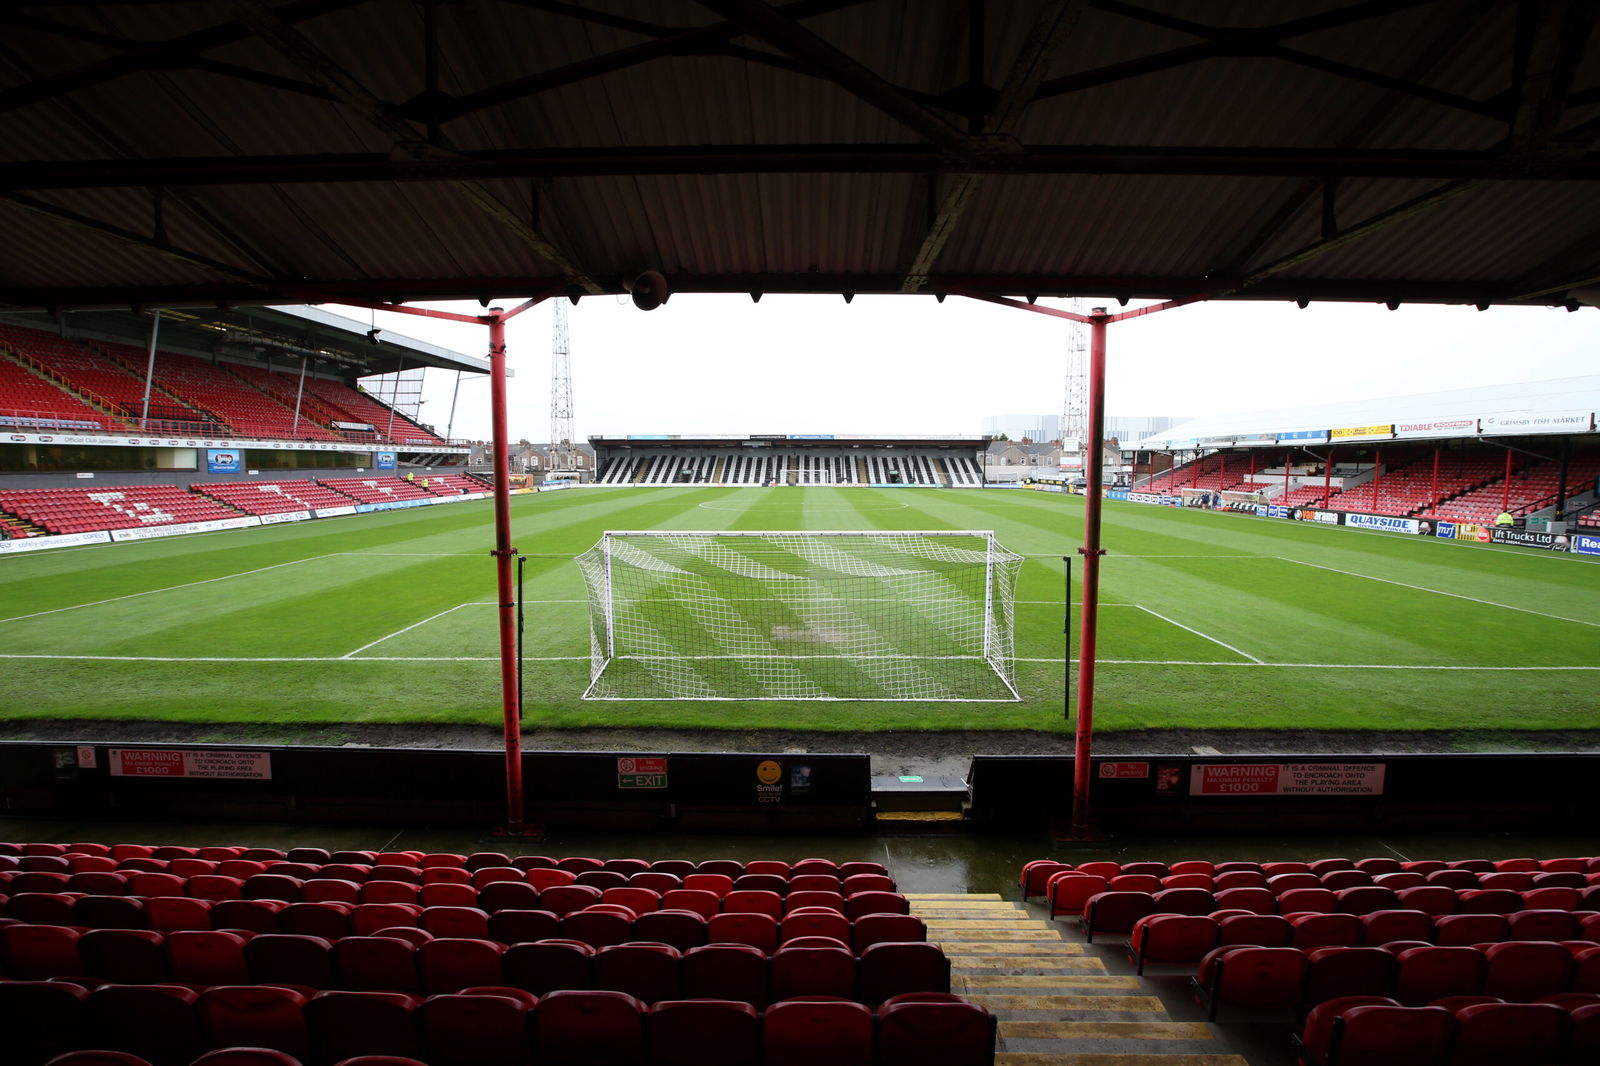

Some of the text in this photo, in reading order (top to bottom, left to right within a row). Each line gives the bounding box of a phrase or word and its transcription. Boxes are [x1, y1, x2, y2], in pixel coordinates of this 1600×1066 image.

[1302, 510, 1338, 522] vanarama
[1350, 515, 1410, 529] QUAYSIDE
[1438, 526, 1456, 538] mrf
[1506, 530, 1534, 542] Trucks
[1536, 534, 1552, 544] Ltd
[124, 752, 181, 762] WARNING
[136, 766, 170, 775] £1000
[1207, 766, 1276, 777] WARNING
[636, 776, 664, 786] EXIT
[1219, 783, 1259, 792] £1000
